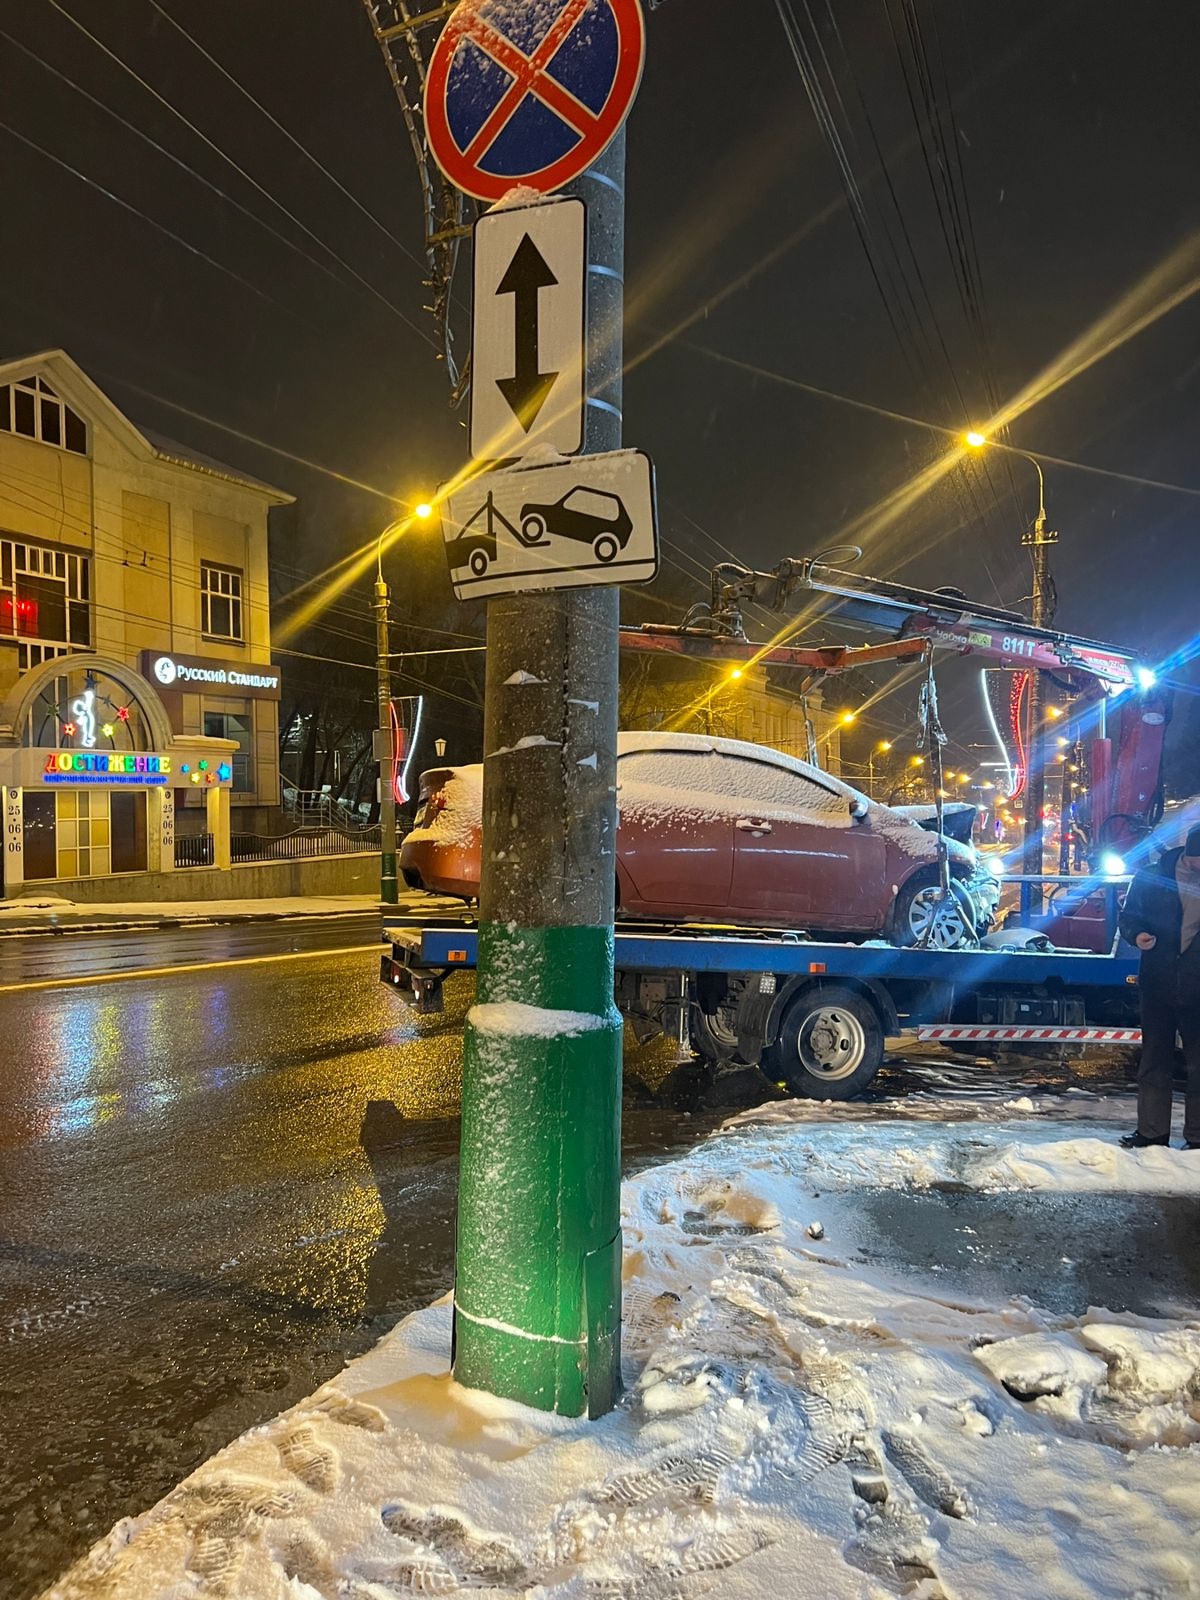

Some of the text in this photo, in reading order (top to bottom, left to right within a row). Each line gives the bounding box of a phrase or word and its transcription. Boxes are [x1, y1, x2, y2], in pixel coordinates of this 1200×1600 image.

[45, 752, 171, 774] ДОСТИЖЕНИЕ
[8, 805, 21, 816] 25
[8, 824, 21, 834] 06
[163, 820, 173, 829] 06
[163, 836, 173, 845] 06
[8, 842, 21, 852] 06
